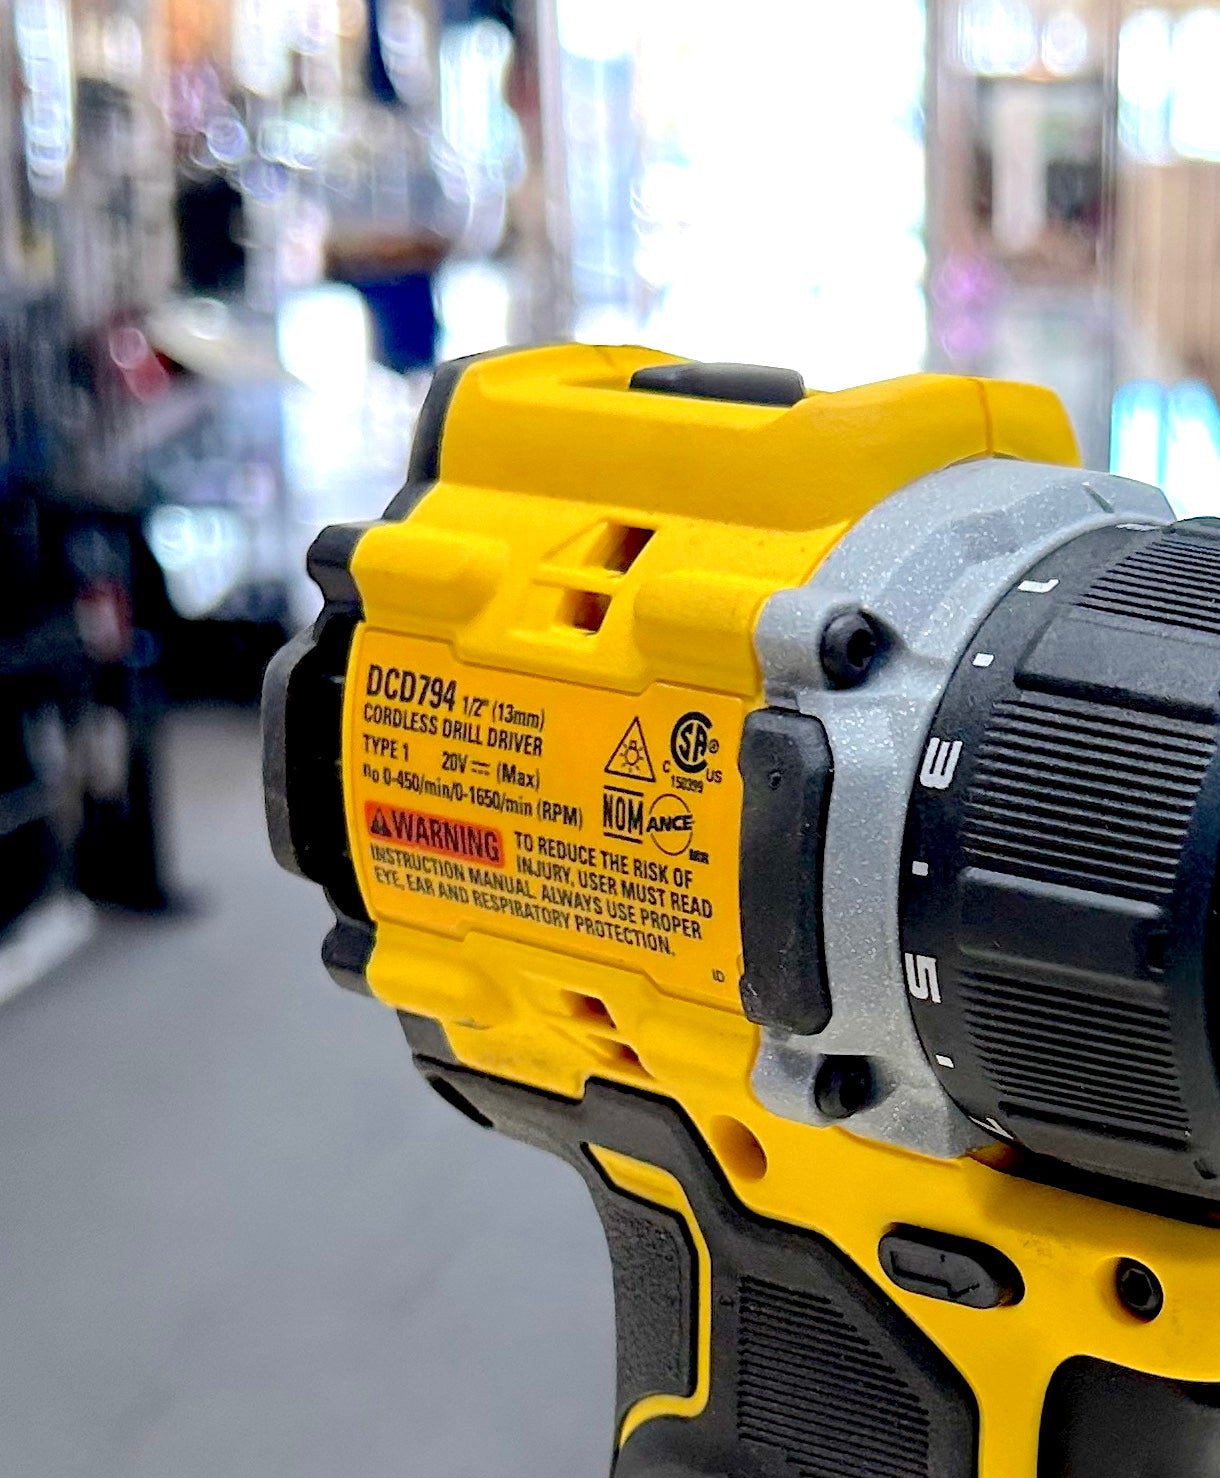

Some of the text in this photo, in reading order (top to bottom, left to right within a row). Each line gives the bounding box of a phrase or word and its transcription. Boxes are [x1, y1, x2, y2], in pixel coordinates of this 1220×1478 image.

[366, 664, 458, 712] DCD794
[492, 699, 546, 733] (13mm)
[363, 702, 543, 757] CORDLESS DRILL DRIVER
[363, 733, 541, 793] TYPE 1 20V (Max)
[662, 759, 671, 773] C
[705, 768, 723, 784] US
[918, 735, 963, 791] 3
[382, 763, 533, 818] 0-450/min/0-1650/min
[536, 799, 583, 831] (RPM)
[603, 792, 644, 836] NOM
[646, 814, 695, 833] ANCE
[391, 809, 500, 863] WARNING
[514, 830, 693, 890] TO REDUCE THE RISK OF
[370, 842, 466, 882] INSTRUCTION
[541, 883, 603, 916] ALWAYS
[606, 899, 636, 925] USE
[640, 907, 702, 940] PROPER
[406, 873, 435, 896] EAR
[438, 880, 469, 904] AND
[472, 889, 571, 931] RESPIRATORY
[574, 913, 675, 957] PROTECTION.
[577, 869, 618, 897] USER
[621, 879, 666, 908] MUST
[670, 891, 713, 919] READ
[904, 951, 942, 1004] 5
